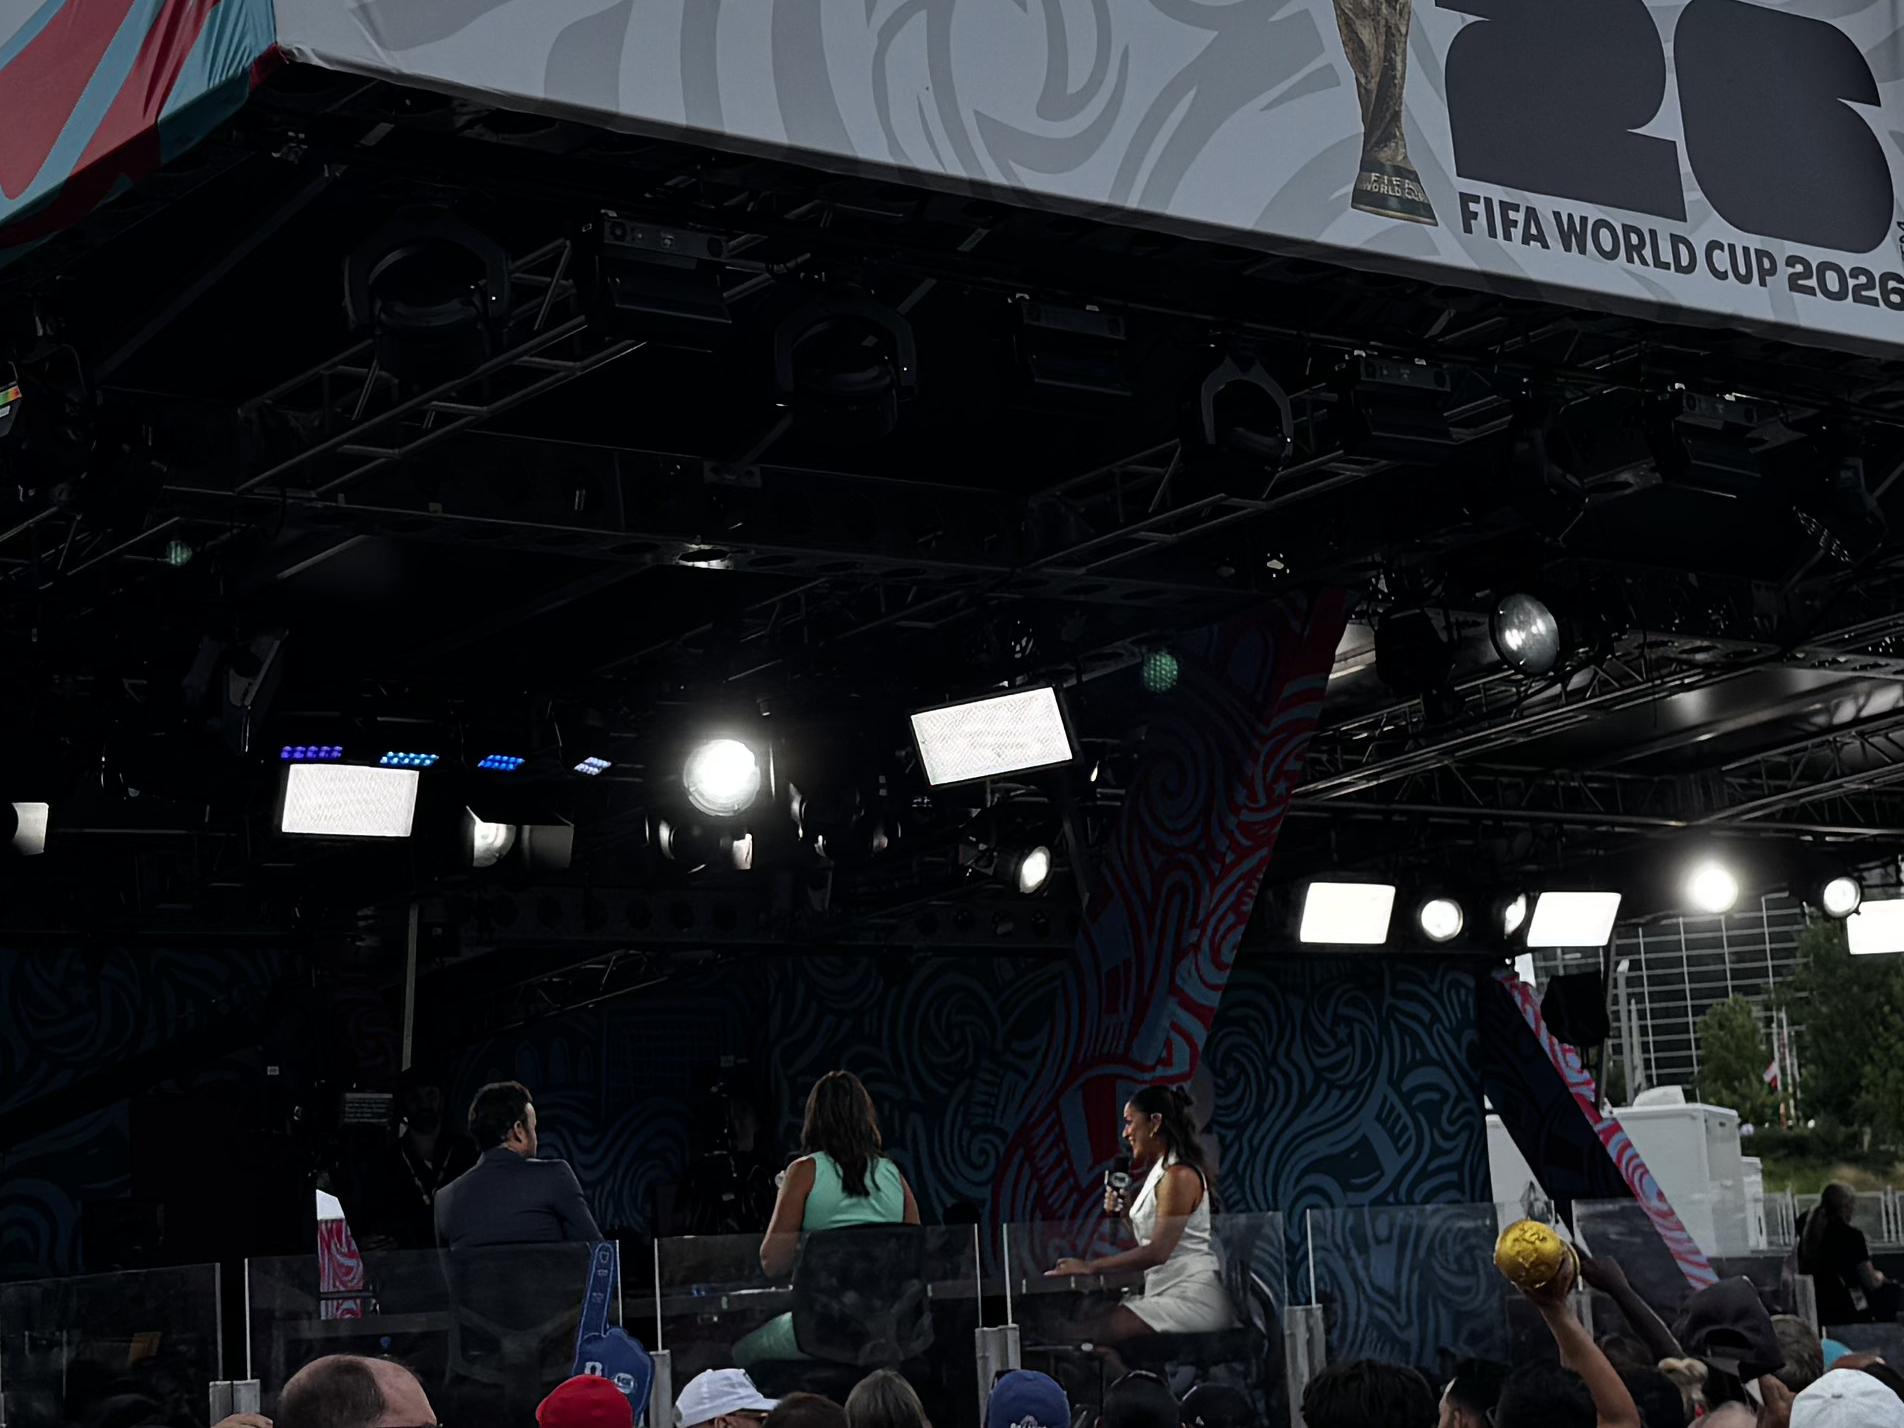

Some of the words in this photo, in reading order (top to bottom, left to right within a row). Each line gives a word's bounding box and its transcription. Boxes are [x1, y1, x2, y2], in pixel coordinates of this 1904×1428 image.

[1458, 191, 1550, 250] FIFA
[1552, 210, 1698, 275] WORLD
[1704, 239, 1778, 288] CUP
